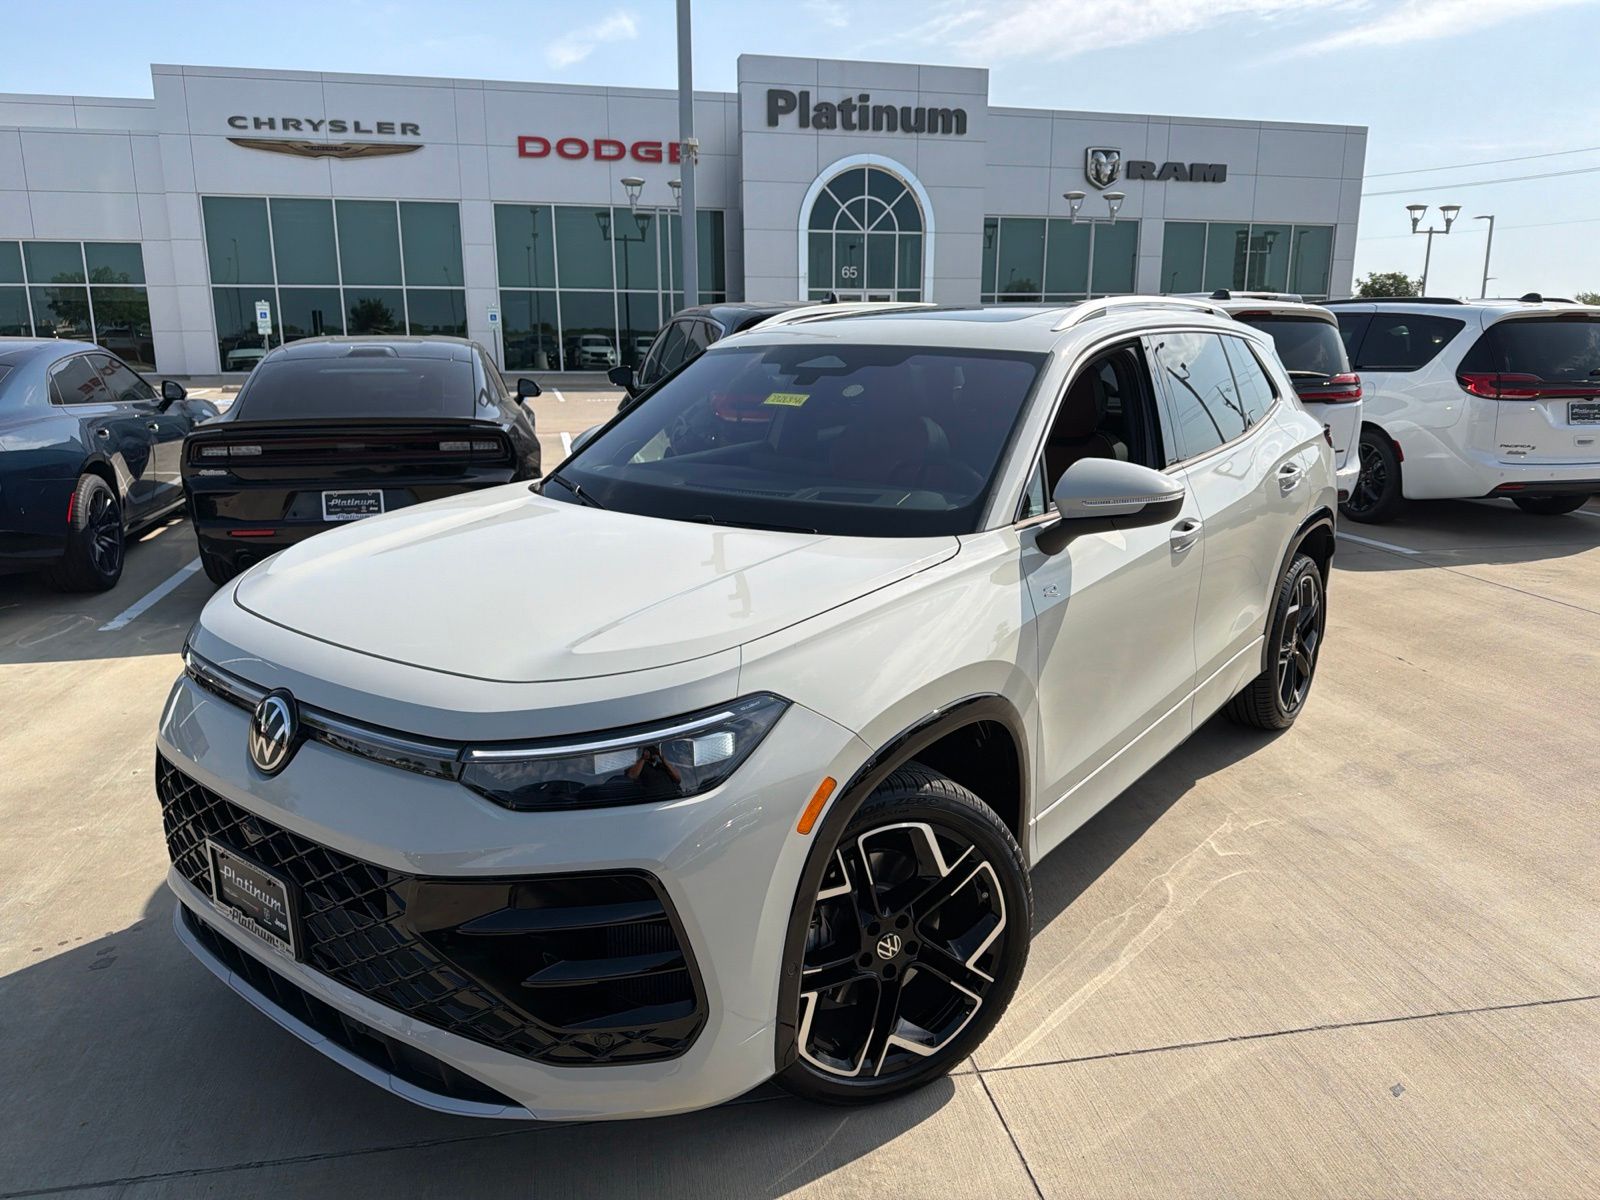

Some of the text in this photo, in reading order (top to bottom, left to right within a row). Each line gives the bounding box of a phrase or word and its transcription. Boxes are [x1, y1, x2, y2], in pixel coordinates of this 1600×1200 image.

[767, 88, 967, 135] Platinum
[227, 115, 421, 136] CHRYSLER
[1126, 160, 1228, 183] RAM
[841, 265, 858, 279] 65
[328, 498, 378, 507] Platinum
[220, 865, 286, 916] Platinum
[231, 908, 280, 948] Platinum
